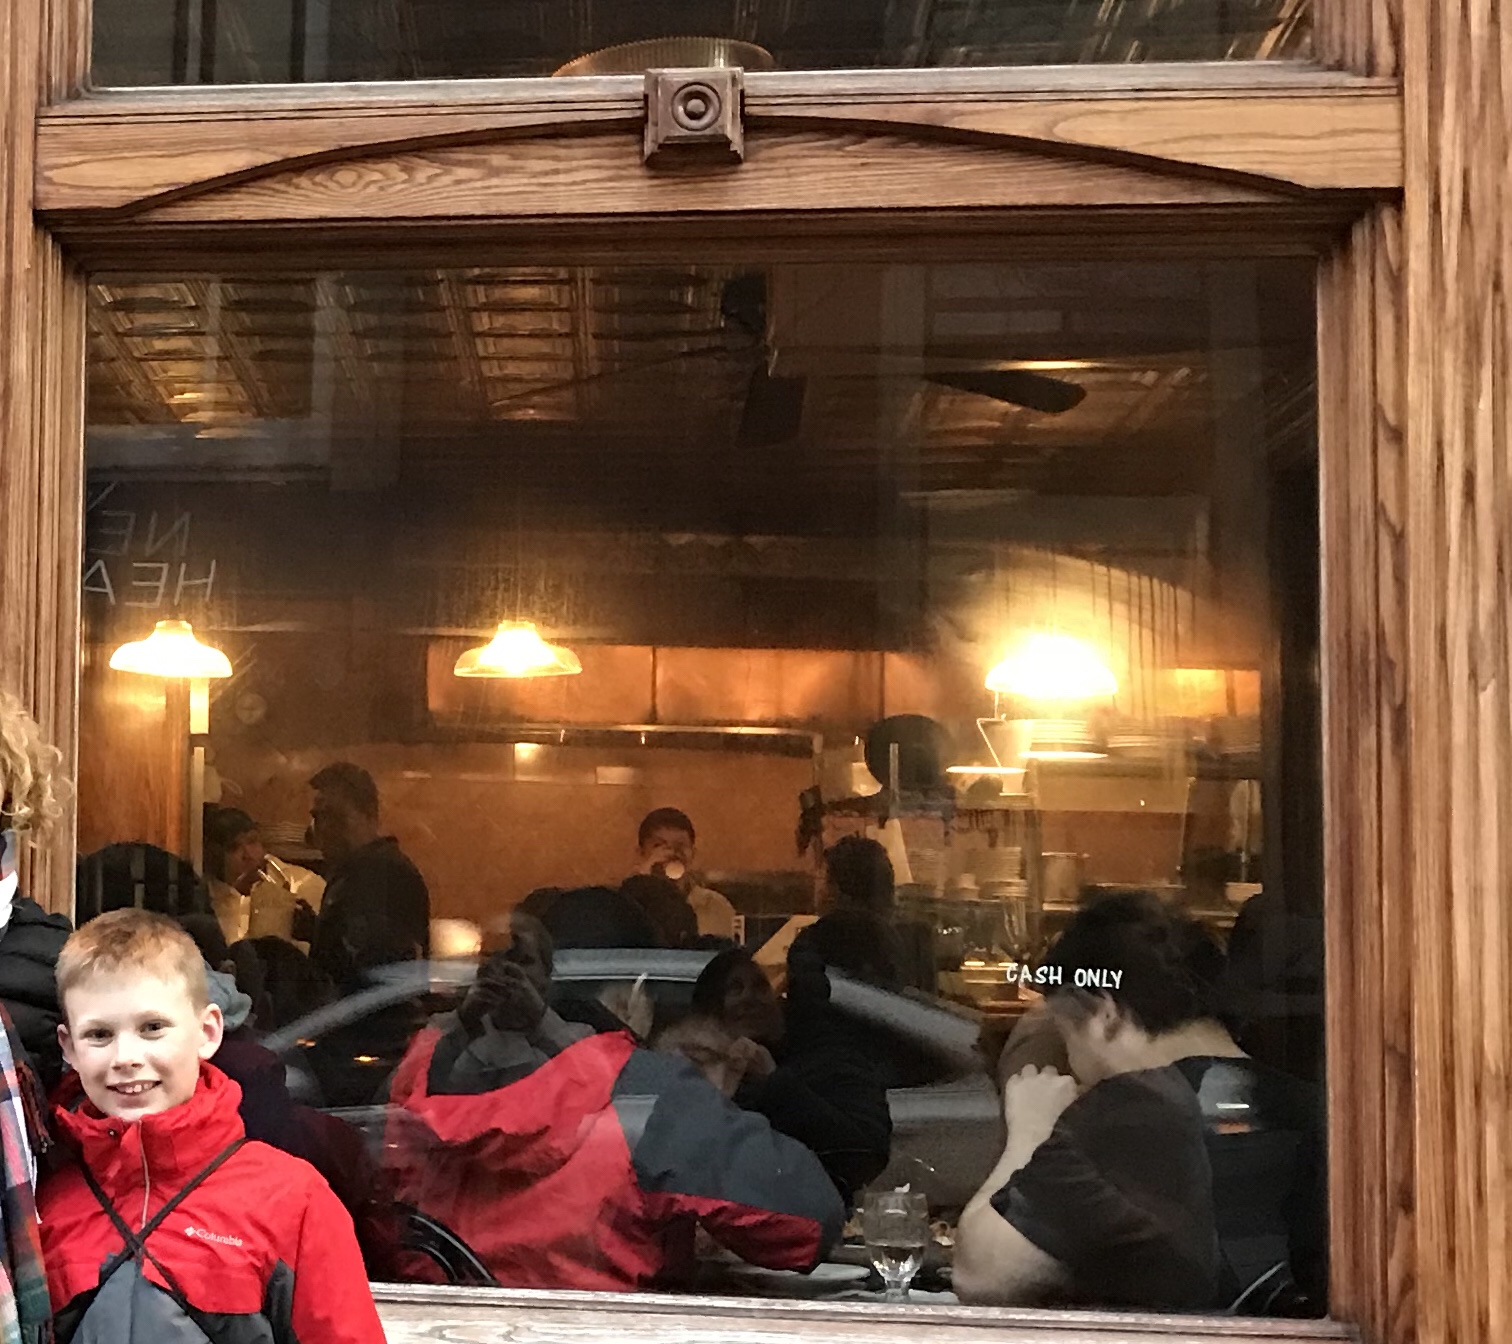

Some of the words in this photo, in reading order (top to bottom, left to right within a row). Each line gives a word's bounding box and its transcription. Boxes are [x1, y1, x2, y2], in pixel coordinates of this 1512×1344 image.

[1006, 964, 1062, 985] CASH
[1074, 968, 1123, 989] ONLY
[196, 1228, 243, 1247] Columbia
